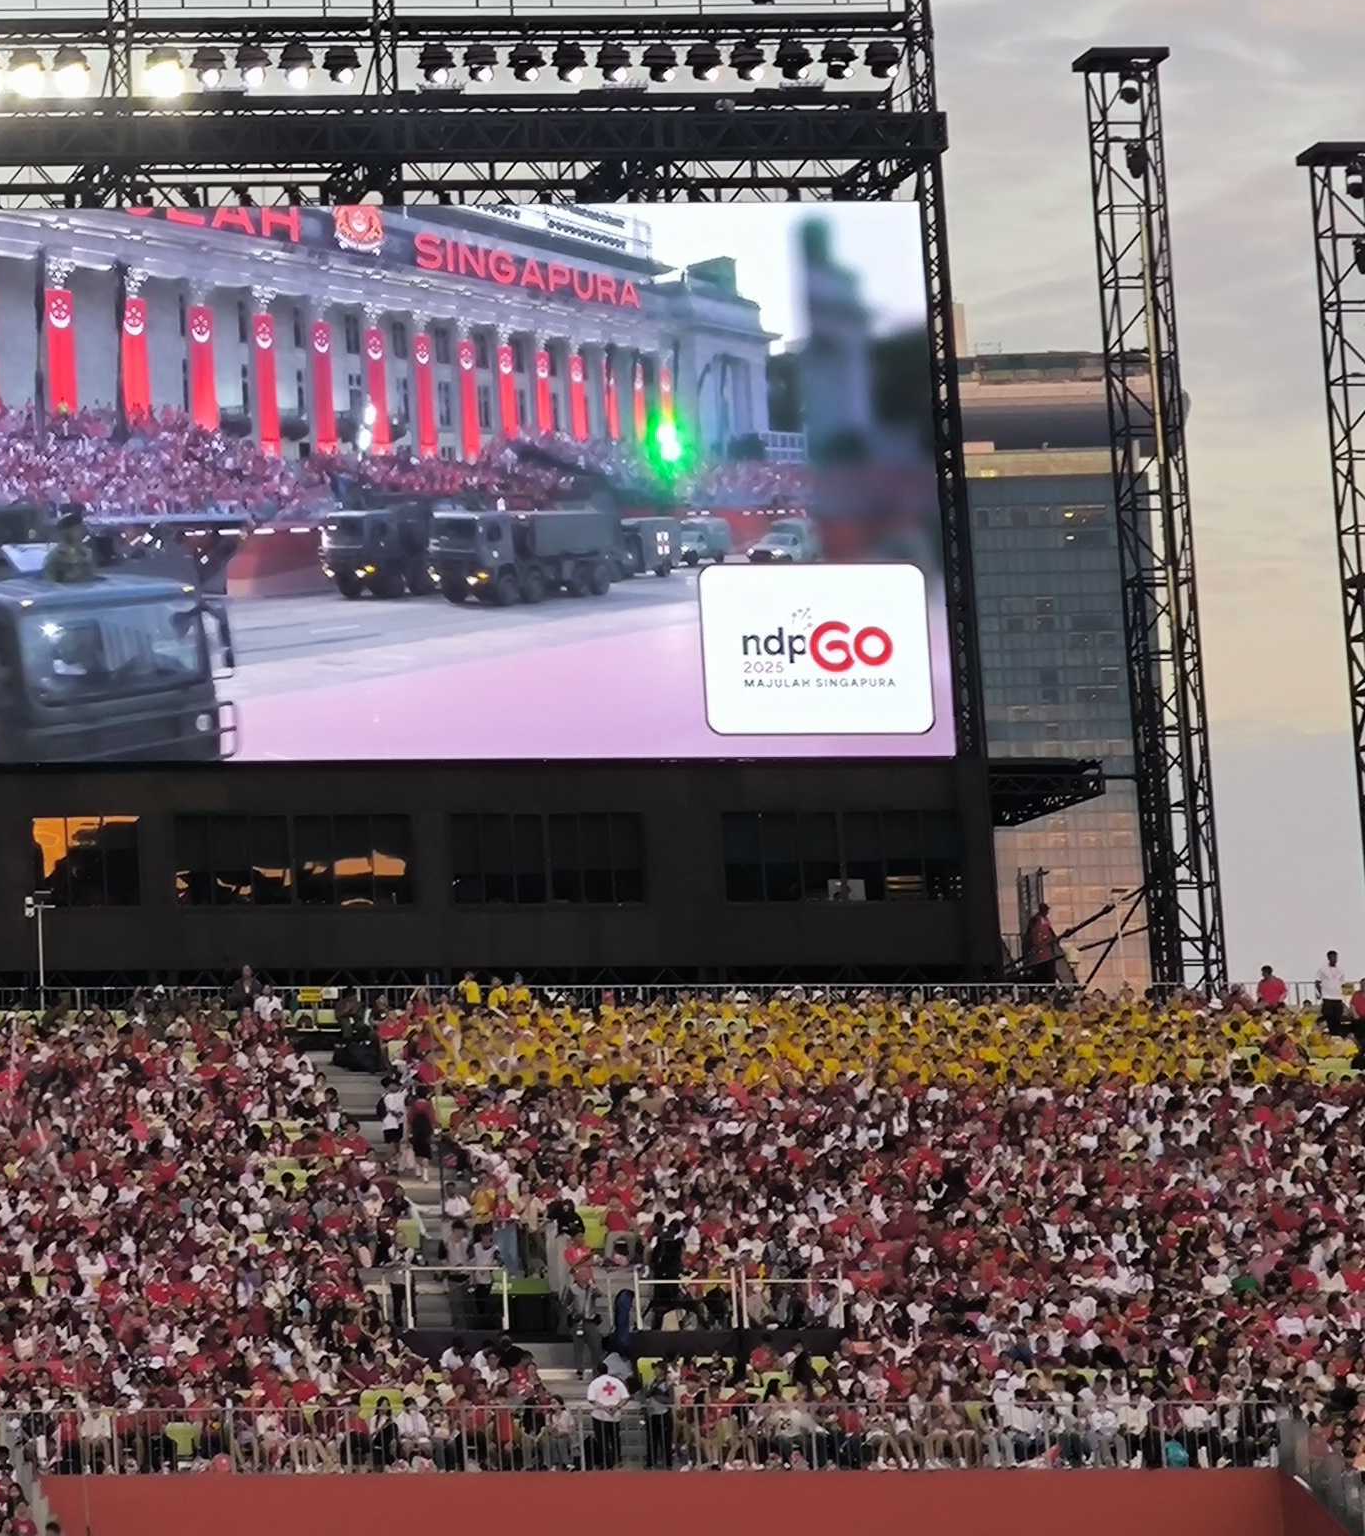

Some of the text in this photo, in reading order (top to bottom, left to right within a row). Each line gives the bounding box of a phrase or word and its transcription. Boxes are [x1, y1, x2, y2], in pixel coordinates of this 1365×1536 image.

[414, 232, 641, 309] SINGAPURA
[743, 661, 784, 674] 2025
[744, 678, 897, 689] MAJULAH SINGAPURA
